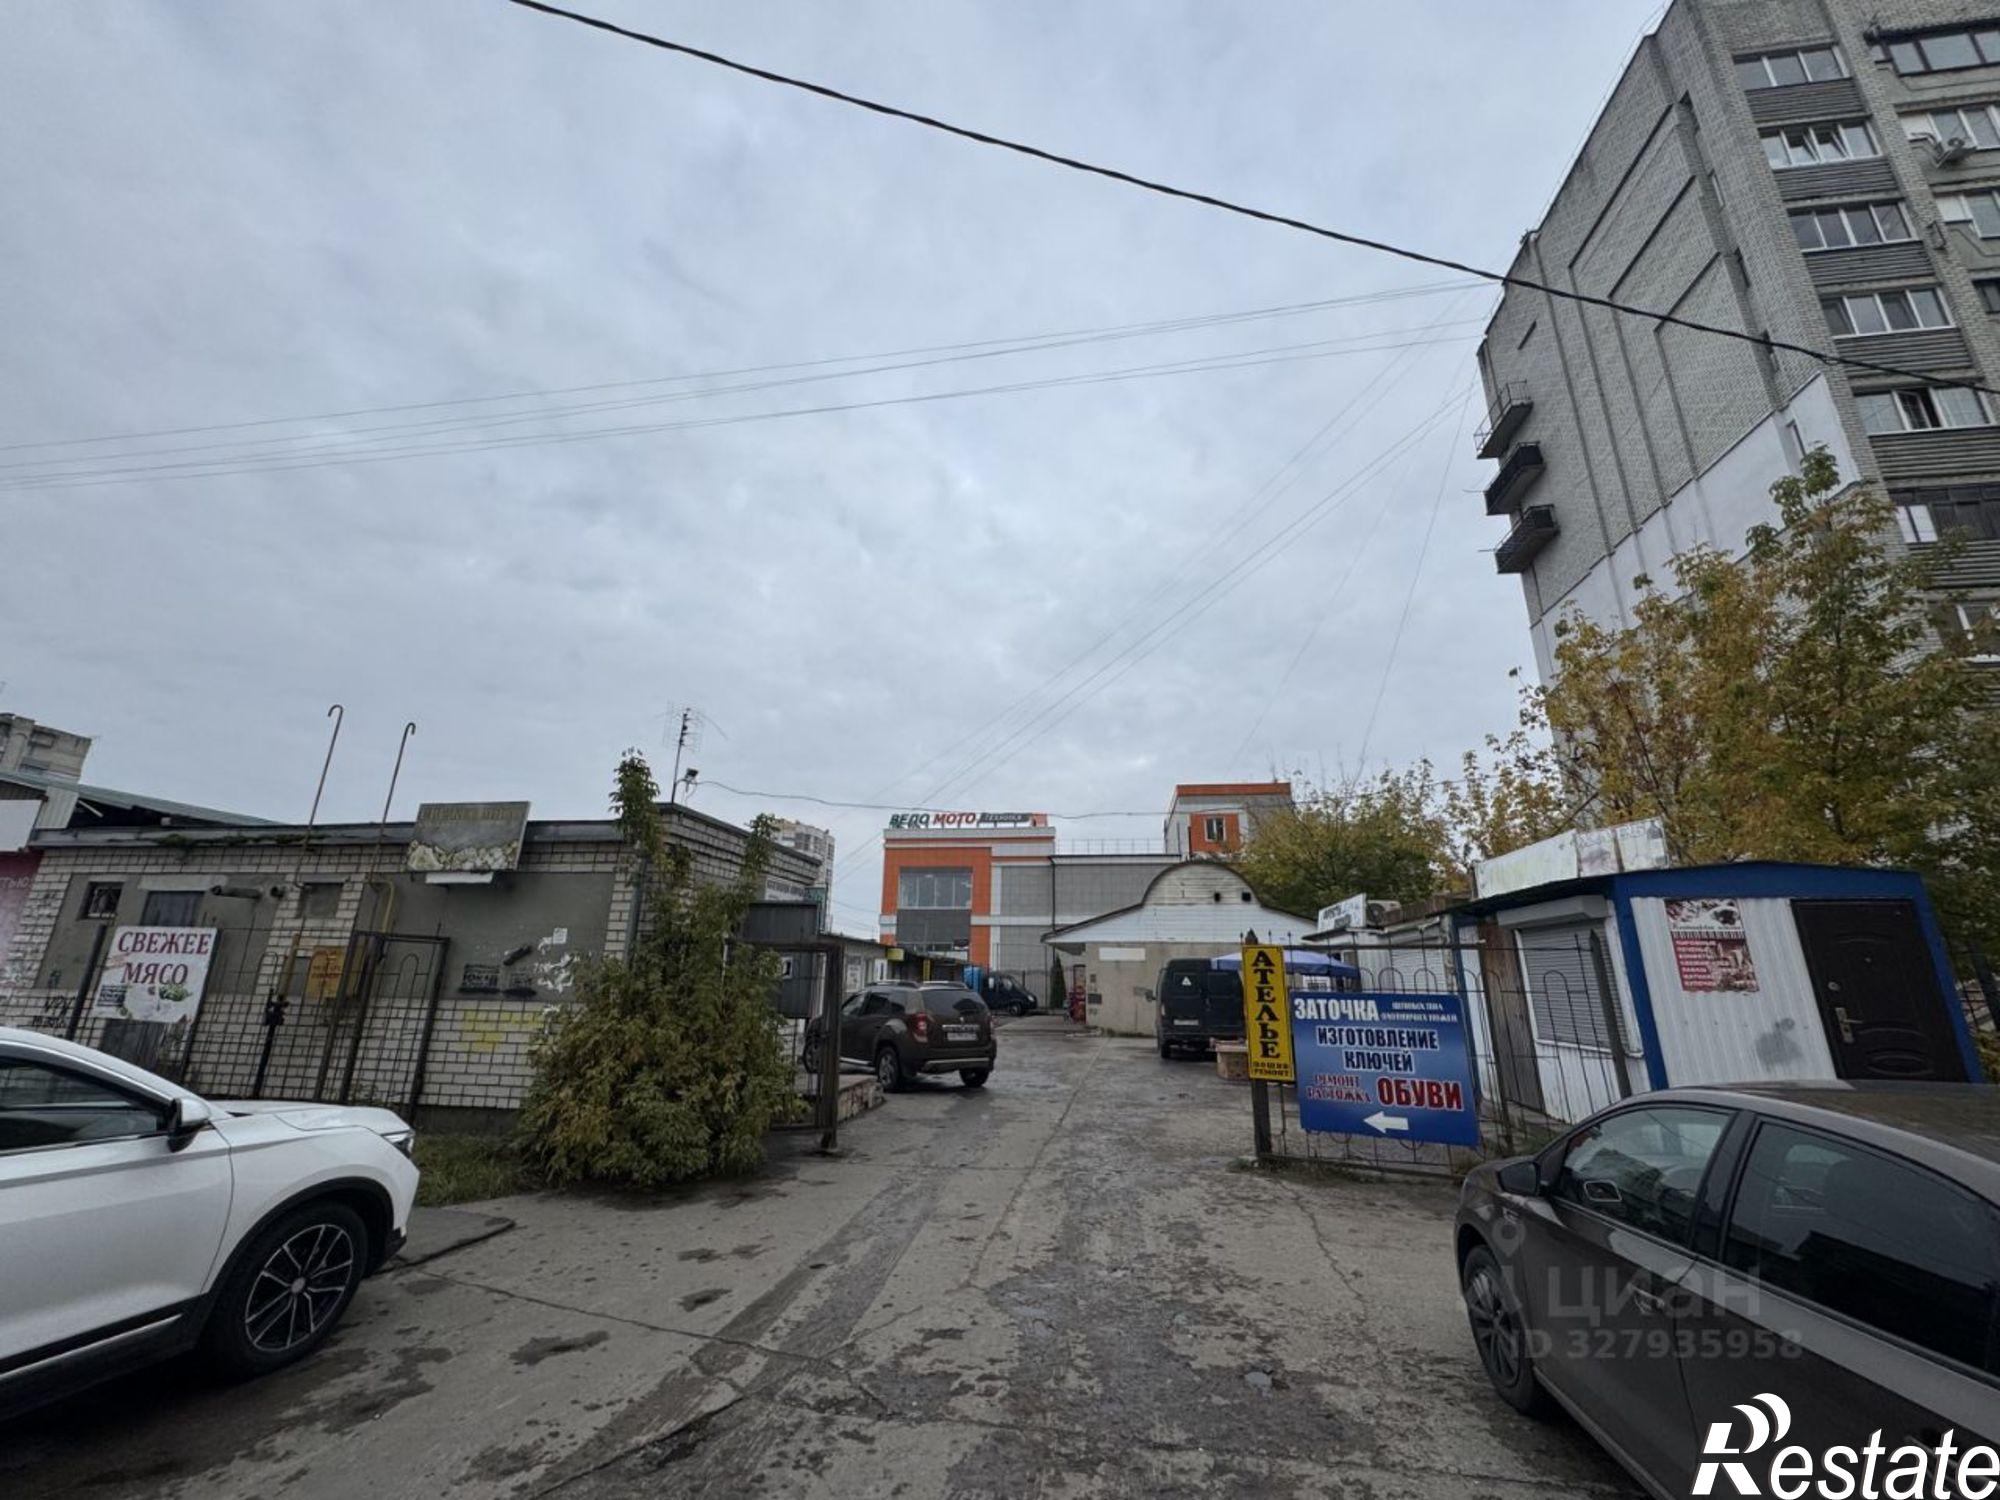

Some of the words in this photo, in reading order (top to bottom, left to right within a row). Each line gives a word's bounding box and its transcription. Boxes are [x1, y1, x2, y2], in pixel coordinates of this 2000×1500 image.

[933, 812, 976, 825] МОТО
[117, 931, 212, 955] СВЕЖЕЕ
[120, 962, 188, 985] МЯСО
[1252, 950, 1281, 1059] АТЕЛЬЕ
[1293, 998, 1380, 1021] ЗАТОЧКА
[1316, 1026, 1439, 1050] ИЗГОТОВЛЕНИЕ
[1344, 1050, 1415, 1073] КЛЮЧЕЙ
[1376, 1077, 1463, 1110] ОБУВИ
